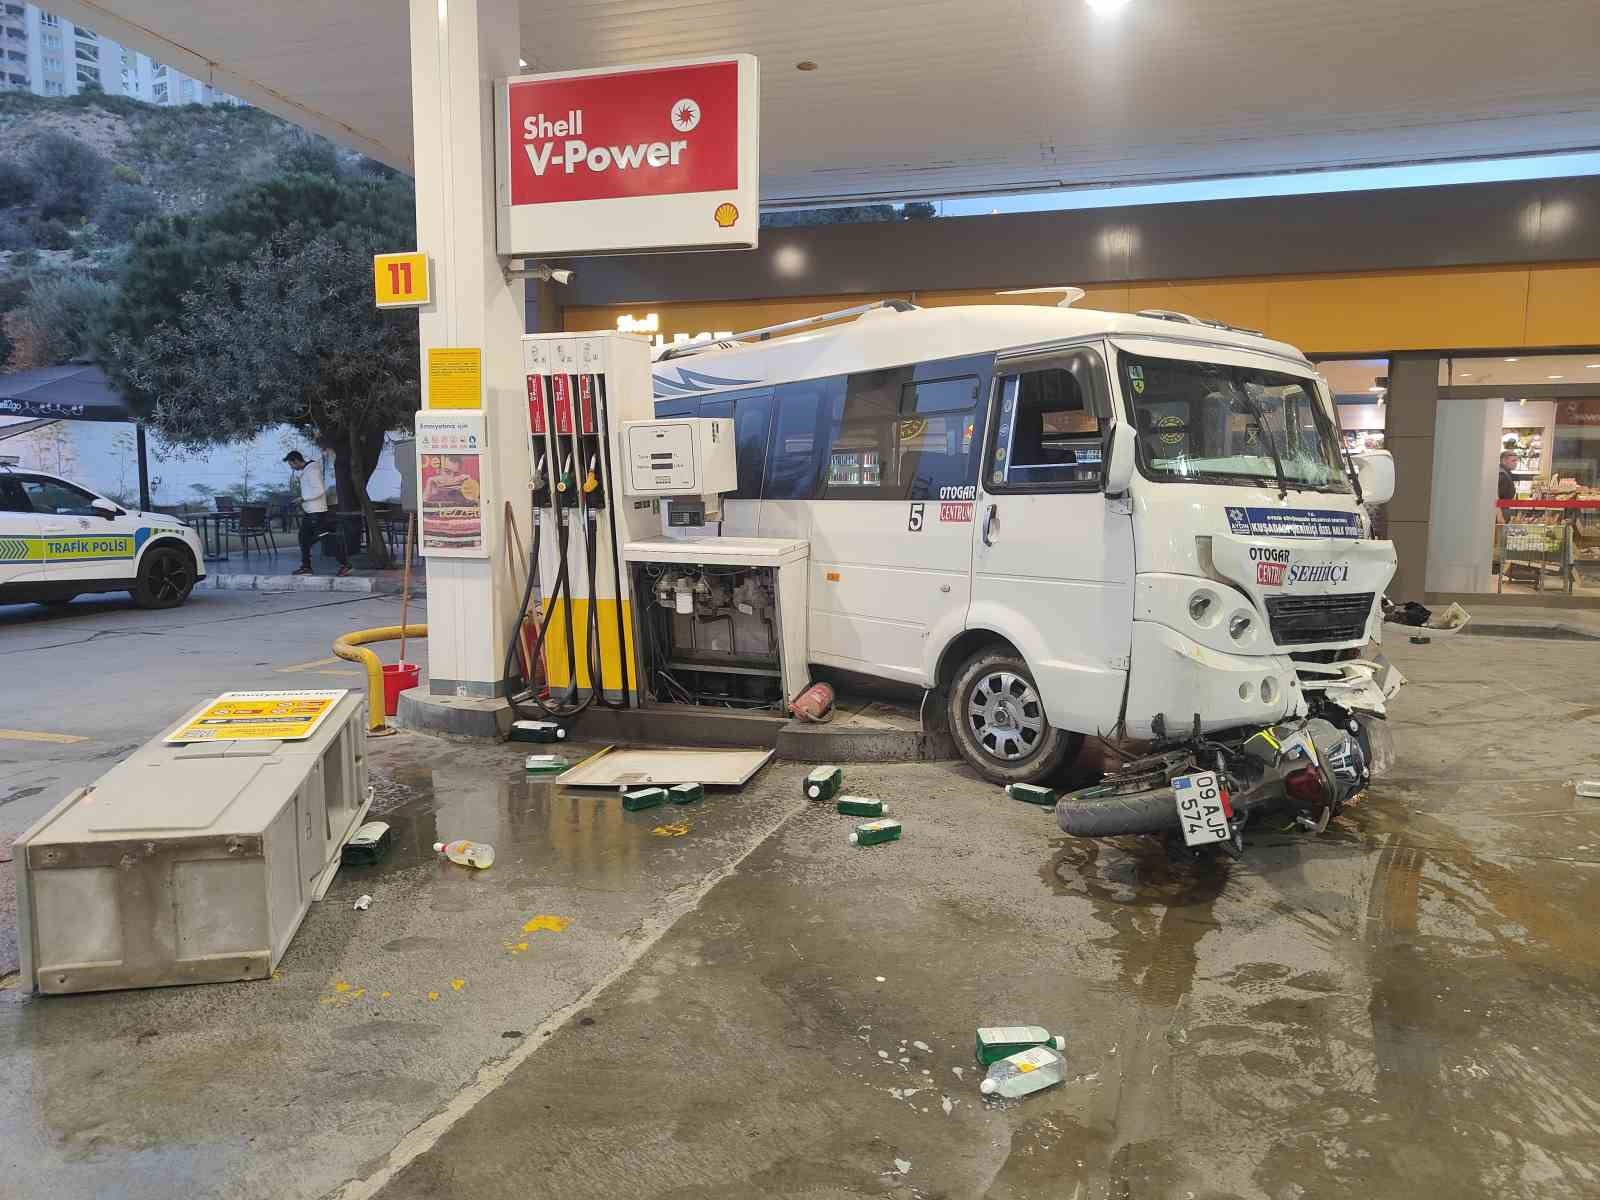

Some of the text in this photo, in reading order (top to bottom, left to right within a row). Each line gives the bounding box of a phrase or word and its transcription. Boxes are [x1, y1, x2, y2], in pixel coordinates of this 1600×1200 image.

[523, 109, 583, 140] Shell
[524, 139, 688, 176] V-Power
[387, 262, 412, 295] 11
[940, 485, 976, 500] OTOGAR
[909, 503, 924, 531] 5
[48, 538, 127, 553] TRAFİK POLİSİ
[1249, 547, 1290, 563] OTOGAR
[1181, 798, 1203, 834] 574
[1196, 776, 1227, 838] 09 AJP
